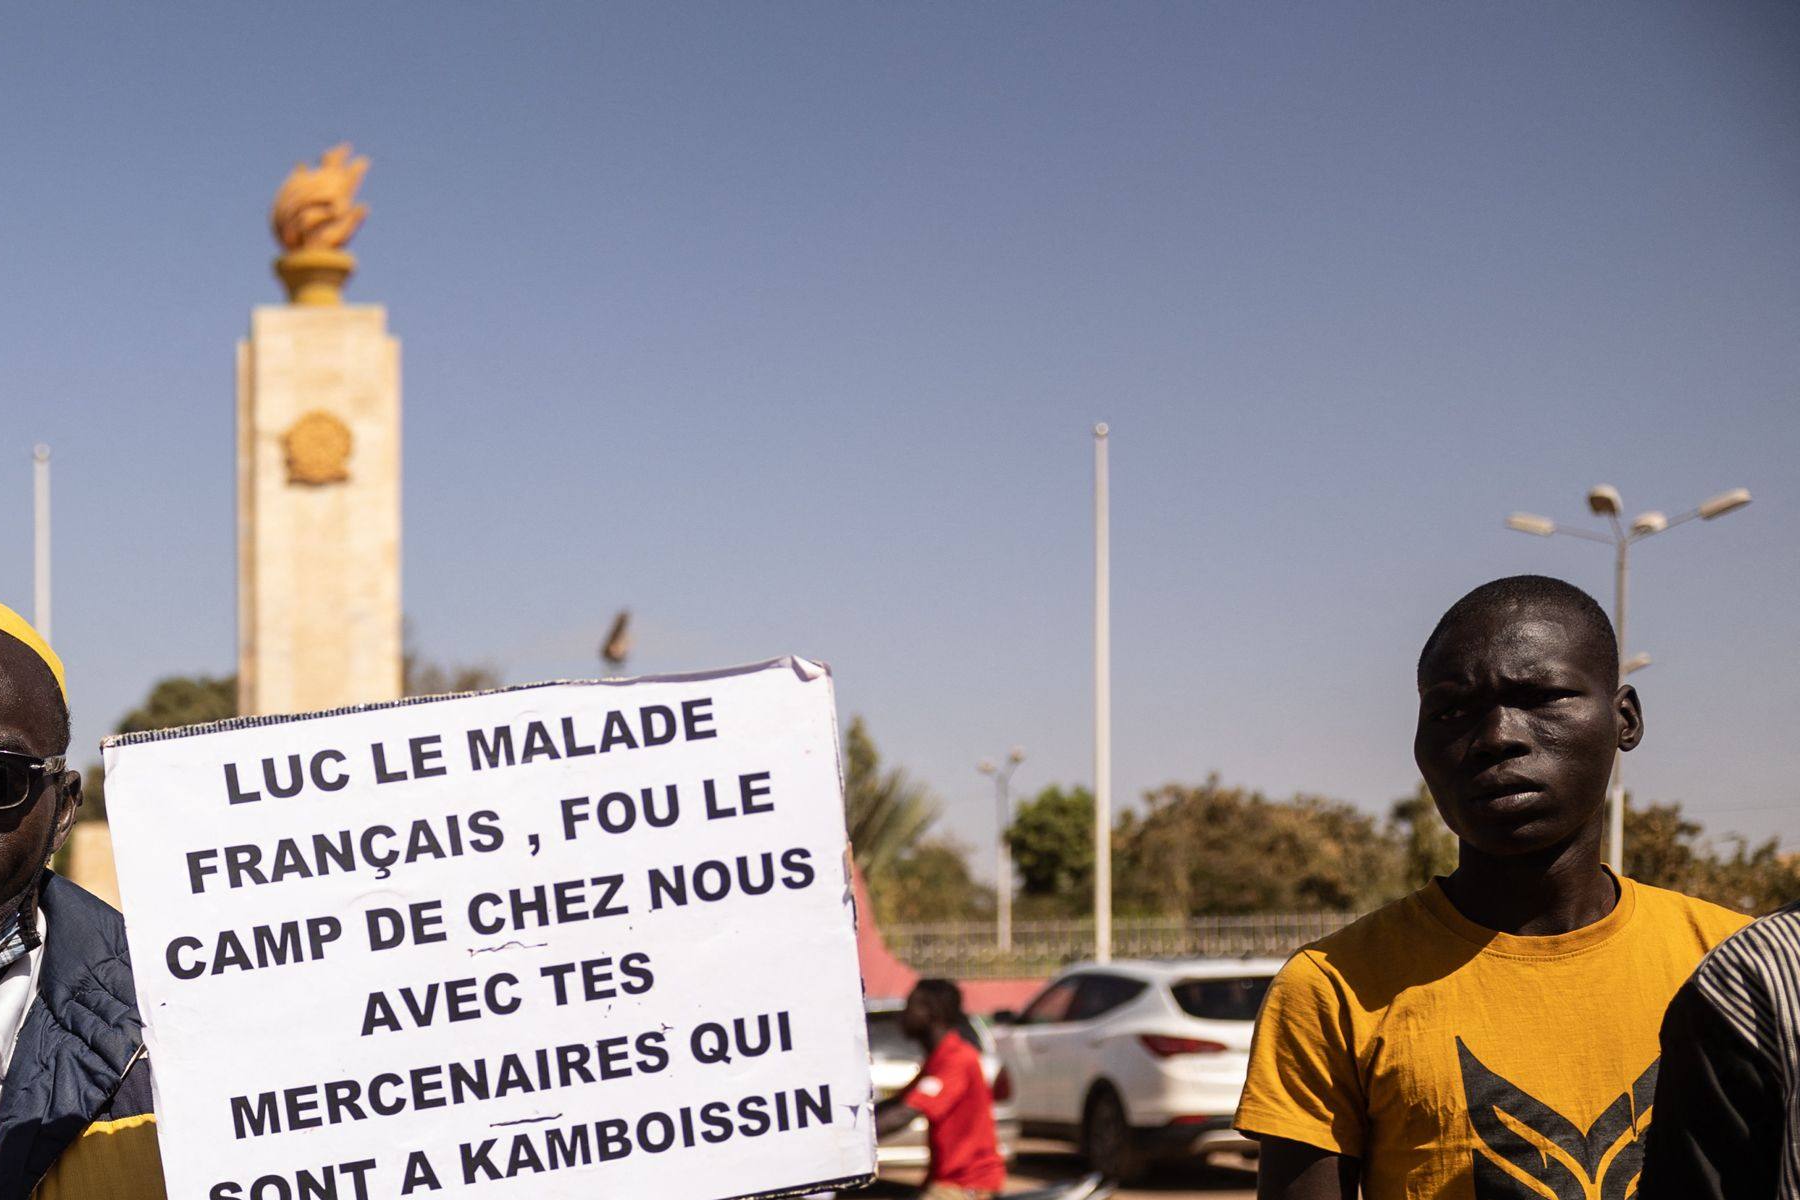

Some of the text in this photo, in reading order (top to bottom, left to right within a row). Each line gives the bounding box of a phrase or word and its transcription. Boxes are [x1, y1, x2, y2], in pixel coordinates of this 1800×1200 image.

[223, 697, 718, 805] LUC LE MALADE
[186, 810, 505, 894] FRANÇAIS
[560, 784, 680, 841] FOU
[703, 771, 775, 821] LE
[165, 847, 816, 980] CAMP DE CHEZ NOUS
[361, 952, 654, 1037] AVEC TES
[230, 1011, 793, 1140] MERCENAIRES QUI
[401, 1150, 443, 1196] A
[459, 1084, 833, 1185] KAMBOISSIN
